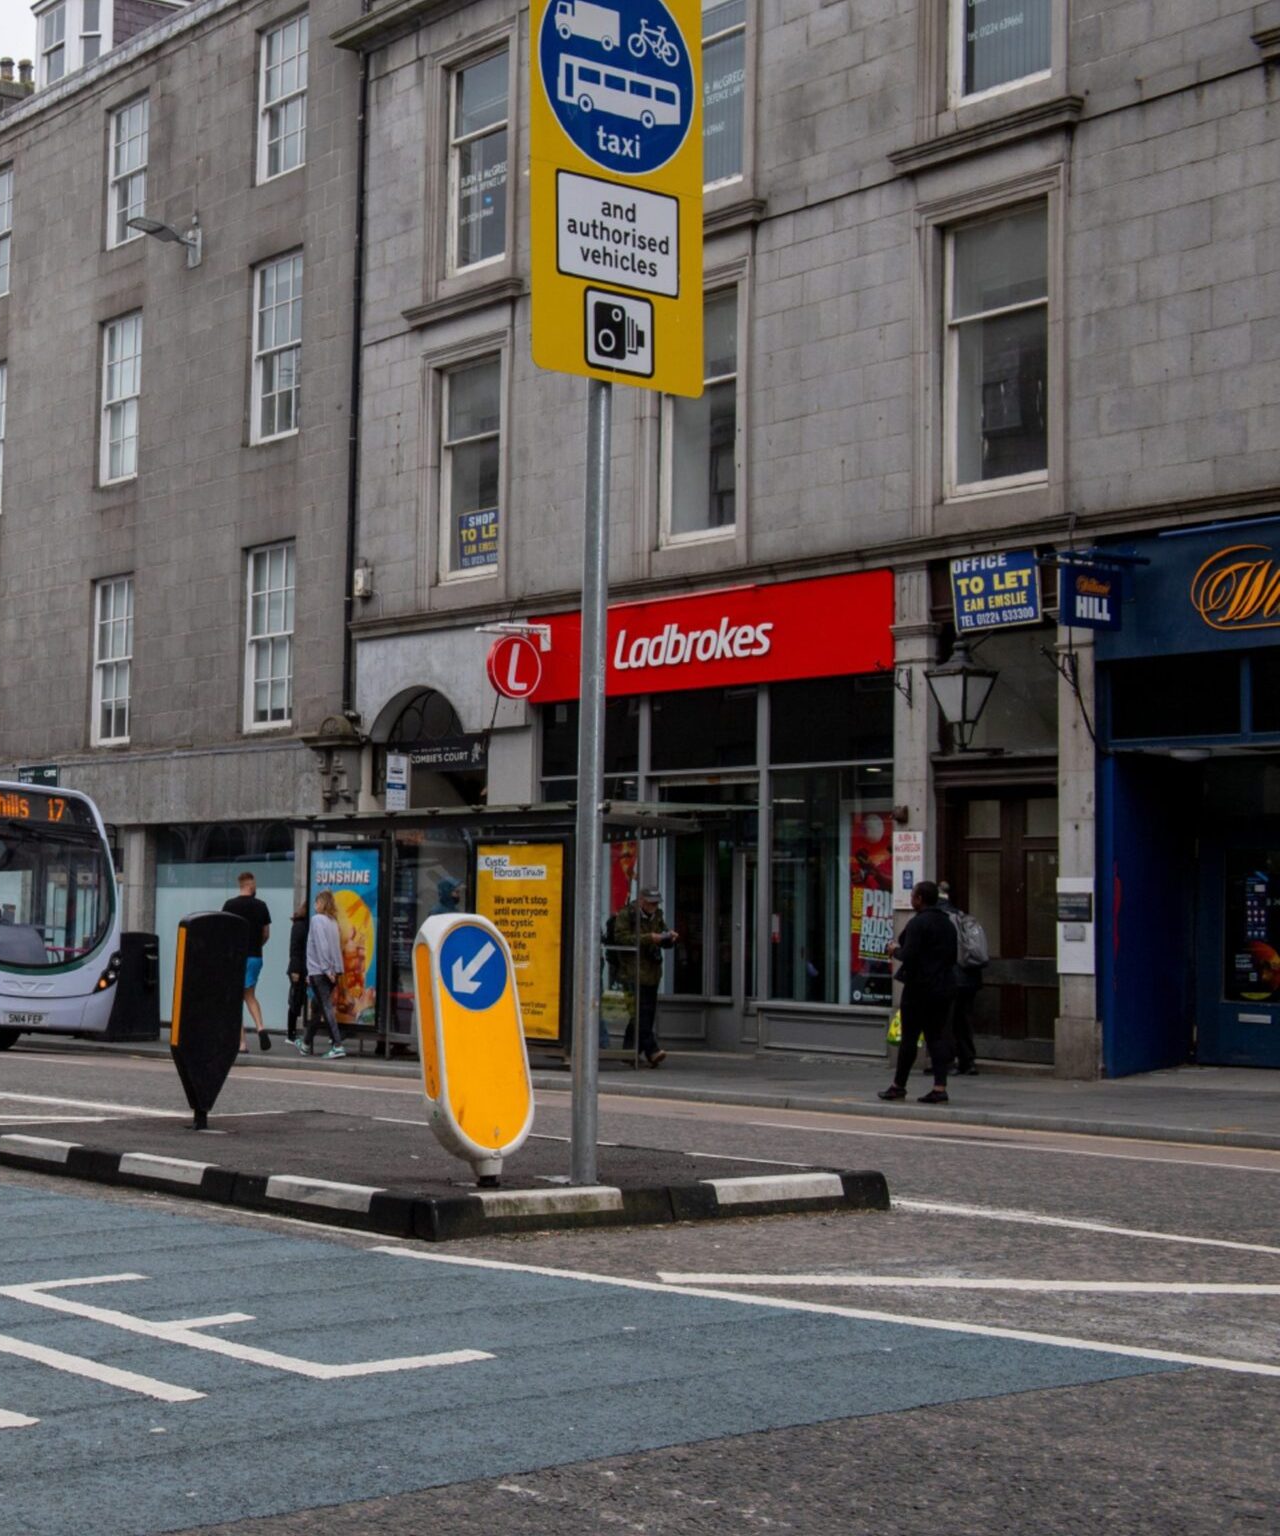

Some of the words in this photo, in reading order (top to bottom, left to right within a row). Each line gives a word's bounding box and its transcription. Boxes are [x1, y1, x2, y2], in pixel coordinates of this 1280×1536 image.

[596, 125, 641, 159] taxi
[601, 201, 636, 223] and
[567, 218, 669, 255] authorised
[580, 246, 658, 277] vehicles
[468, 511, 495, 528] SHOP
[461, 528, 477, 543] TO
[952, 553, 1007, 574] OFFICE
[957, 576, 984, 596] TO
[992, 568, 1032, 592] LET
[964, 598, 984, 612] EAN
[988, 591, 1027, 610] EMSLIE
[1075, 595, 1111, 622] HILL
[960, 614, 974, 627] TEL
[976, 610, 1000, 626] 01224
[613, 617, 773, 670] Ladbrokes
[506, 643, 528, 690] L
[444, 751, 469, 762] COURT
[48, 797, 65, 824] 17
[484, 857, 508, 869] Cystic
[316, 870, 370, 884] SUNSHINE
[506, 895, 529, 905] won't
[531, 896, 548, 907] stop
[494, 906, 510, 916] until
[511, 908, 548, 918] everyone
[510, 919, 534, 930] cystic
[522, 931, 536, 939] can
[859, 936, 886, 954] EVERY
